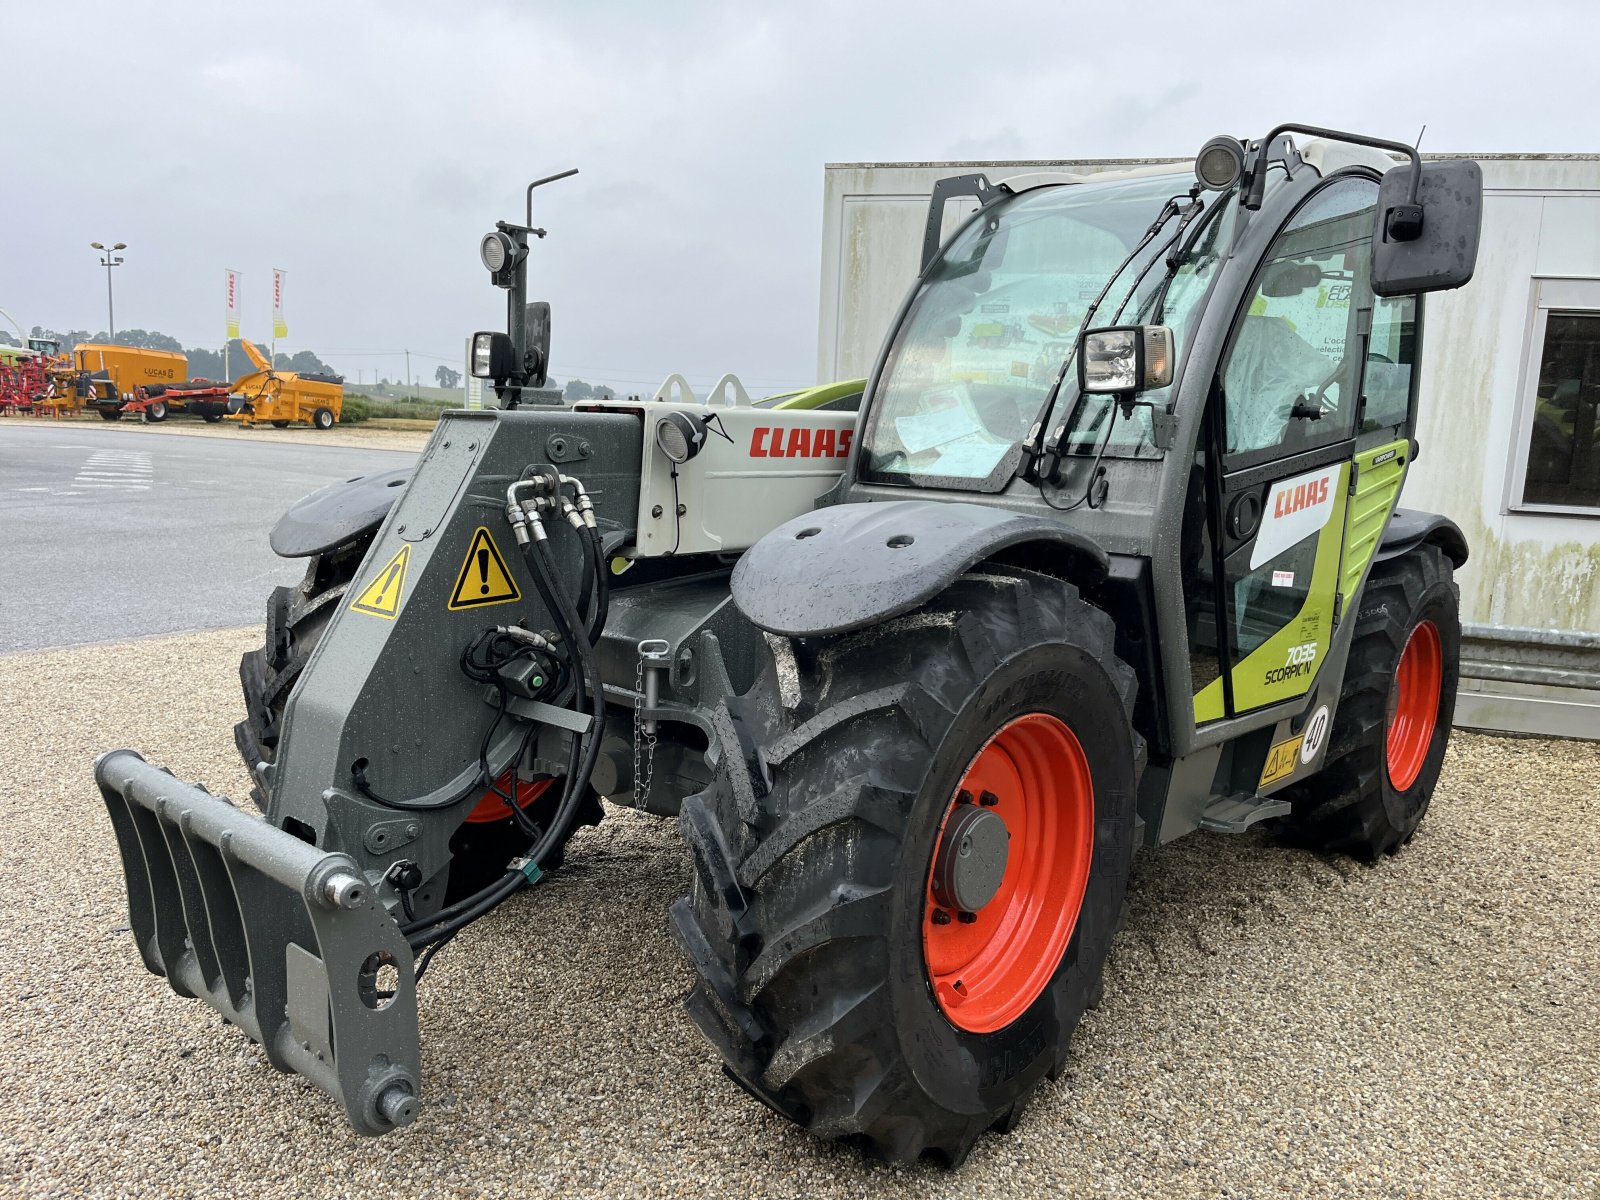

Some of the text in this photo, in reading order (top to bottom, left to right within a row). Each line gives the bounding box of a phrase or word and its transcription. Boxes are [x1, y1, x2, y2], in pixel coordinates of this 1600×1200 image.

[144, 367, 167, 376] LUCAS
[749, 427, 854, 458] CLAAS
[1274, 477, 1329, 519] CLAAS
[1285, 642, 1317, 667] 7035
[1306, 714, 1326, 752] 40
